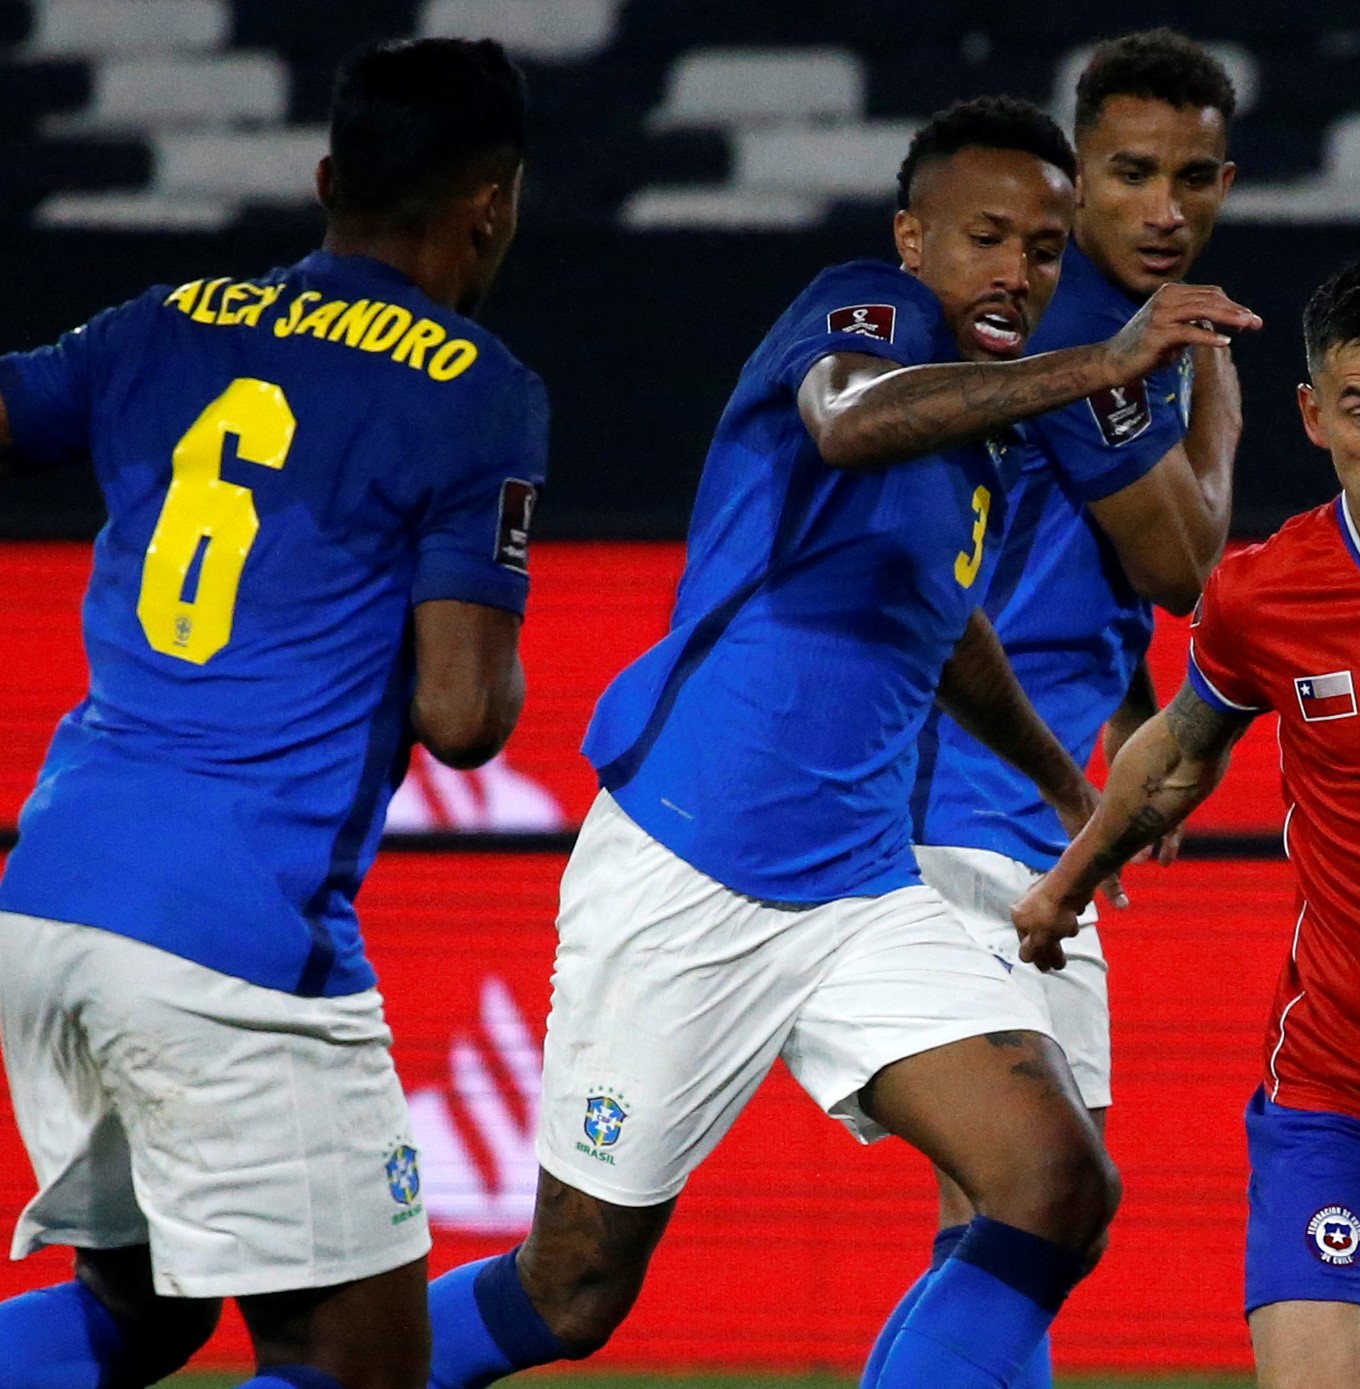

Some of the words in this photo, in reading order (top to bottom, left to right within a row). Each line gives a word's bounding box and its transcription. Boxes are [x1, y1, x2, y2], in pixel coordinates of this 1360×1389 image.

[163, 277, 286, 327] ALEX
[273, 291, 479, 382] SANDRO
[137, 377, 298, 665] 6
[954, 485, 991, 589] 3
[576, 1141, 616, 1166] BRASIL
